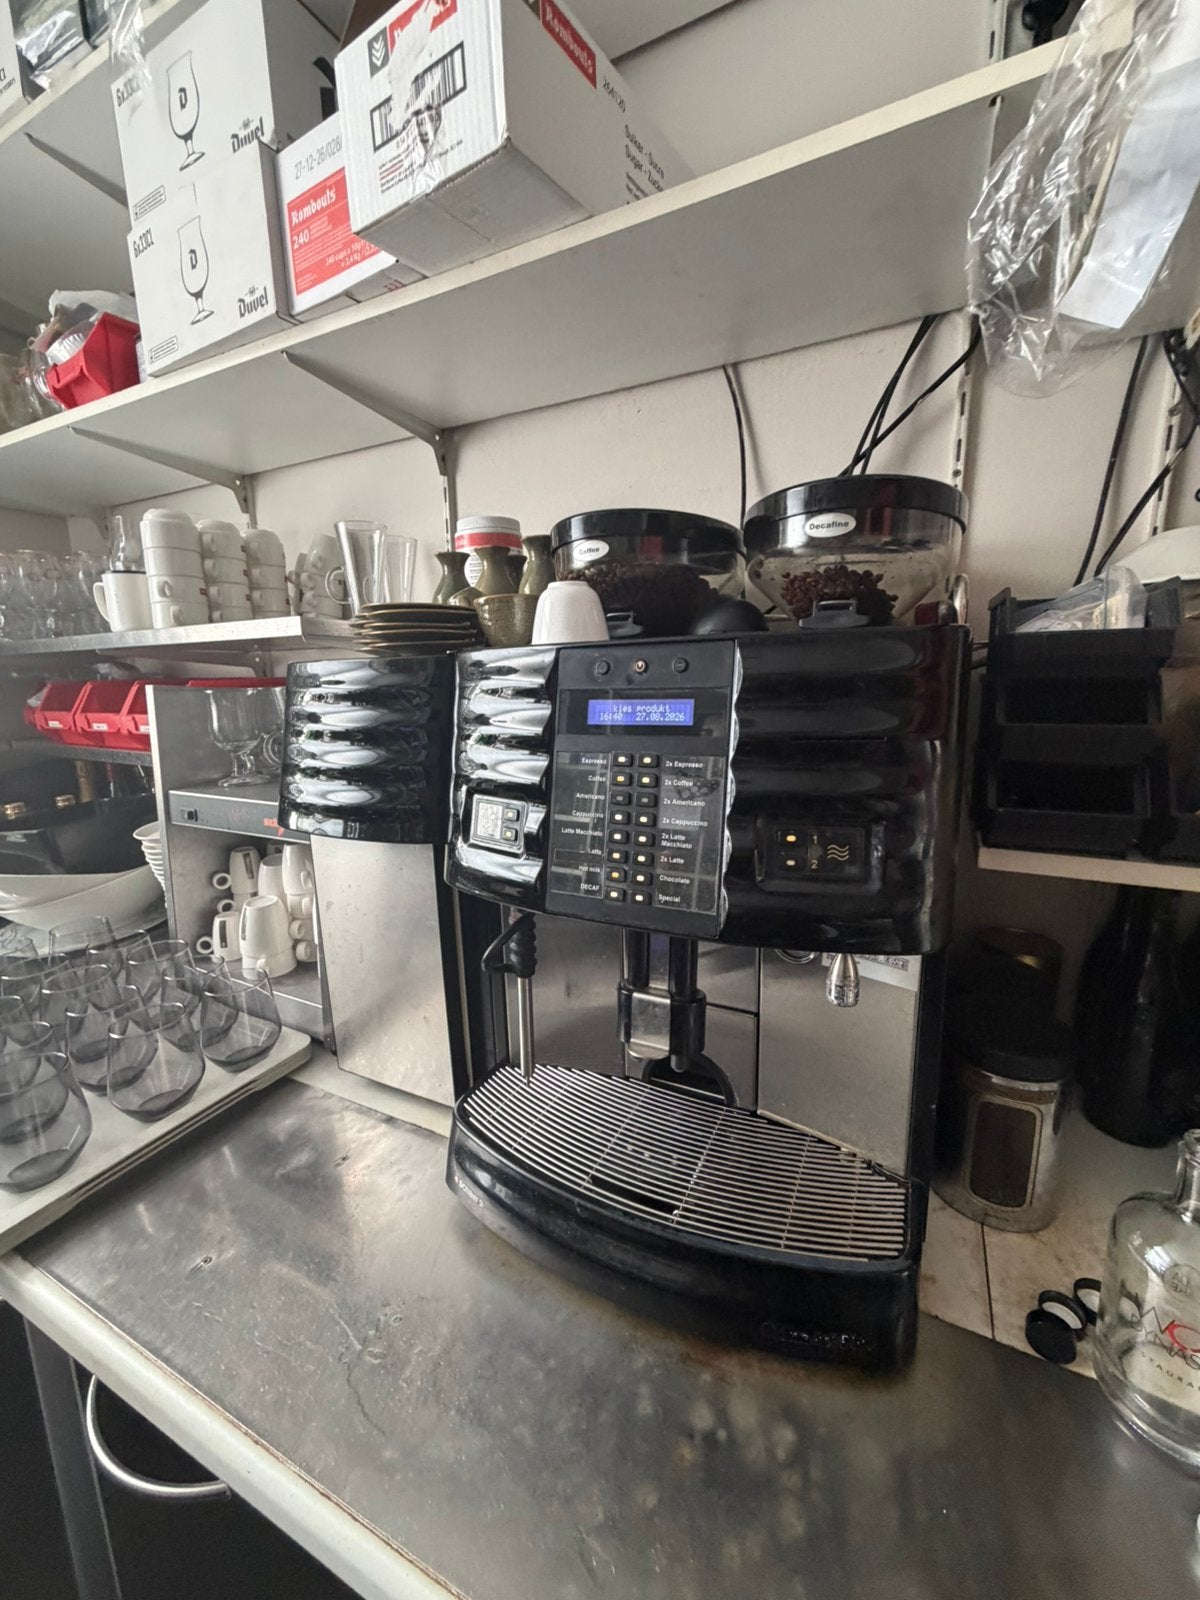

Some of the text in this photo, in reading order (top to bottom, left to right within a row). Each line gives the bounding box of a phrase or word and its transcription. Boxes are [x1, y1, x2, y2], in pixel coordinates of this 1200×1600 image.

[231, 116, 265, 154] Duvel
[291, 186, 336, 226] Rombouts
[293, 229, 310, 249] 240
[237, 286, 269, 319] Duvel
[809, 521, 850, 530] Decafine
[579, 546, 600, 556] Coffee
[613, 704, 632, 713] kies
[600, 712, 623, 721] 16:40
[581, 757, 608, 766] Espresso
[674, 761, 704, 769] Espresso
[673, 779, 693, 787] Coffee
[576, 793, 605, 801] Americano
[672, 799, 706, 807] Americano
[572, 810, 604, 819] Cappuccino
[671, 817, 708, 828] Cappuccino
[573, 828, 603, 837] Macchiato
[670, 833, 686, 841] Latte
[812, 835, 818, 844] 1
[661, 841, 692, 849] Macchiato
[668, 856, 684, 864] Latte
[811, 860, 818, 869] 2
[659, 875, 690, 885] Chocolate
[580, 883, 600, 892] DECAF
[658, 894, 681, 903] Special
